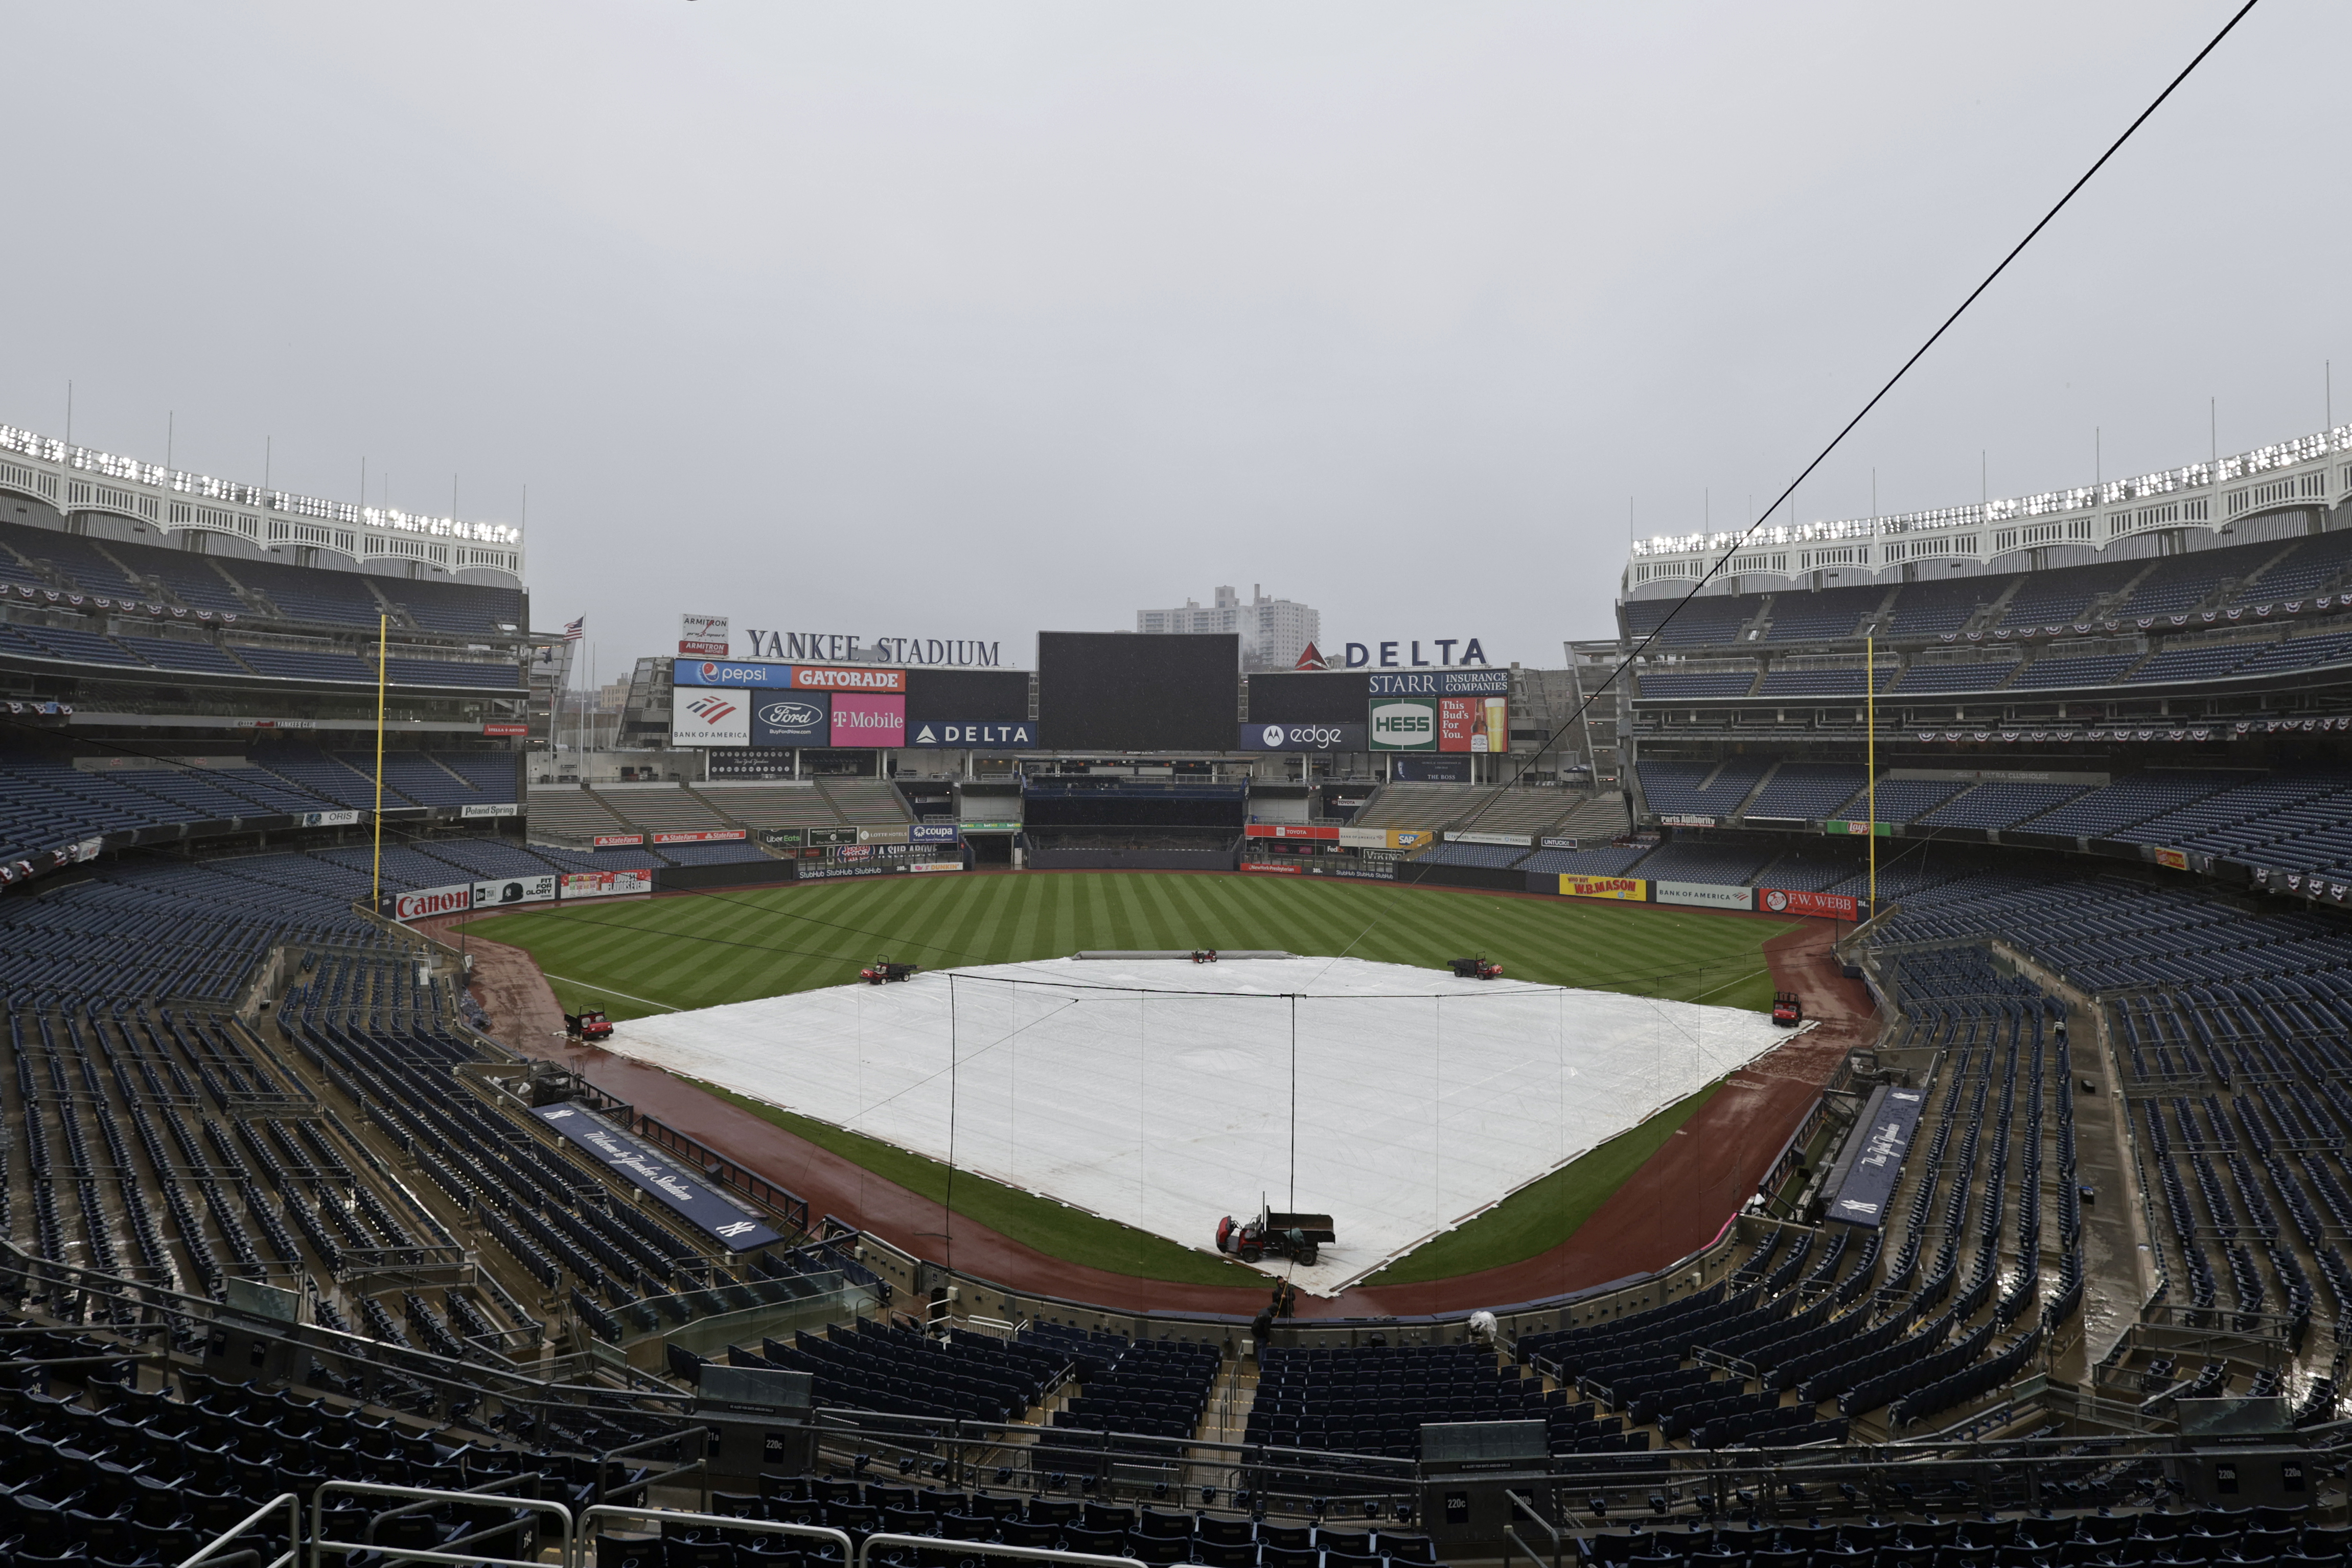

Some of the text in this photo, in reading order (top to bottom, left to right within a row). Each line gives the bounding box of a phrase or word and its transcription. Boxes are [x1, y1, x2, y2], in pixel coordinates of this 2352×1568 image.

[684, 618, 726, 627] ARMITRON
[745, 629, 1001, 666] YANKEE STADIUM
[1346, 638, 1489, 668] DELTA
[722, 667, 766, 683] pepsi
[798, 671, 898, 688] GATORADE
[1446, 673, 1508, 683] INSURANCE
[1369, 675, 1438, 693] STARR
[1445, 682, 1508, 692] COMPANIES
[1442, 701, 1464, 709] This
[770, 706, 812, 724] Ford
[1442, 710, 1469, 719] Bud's
[1376, 717, 1429, 732] HESS
[1442, 720, 1459, 729] For
[945, 726, 1029, 743] DELTA
[1290, 725, 1342, 749] edge
[1442, 730, 1463, 739] You.
[465, 805, 514, 816] Poland Spring
[329, 812, 352, 821] ORIS
[1681, 815, 1715, 824] Authority
[926, 826, 953, 837] coupa
[1849, 822, 1867, 834] Lay's
[1399, 835, 1415, 844] SAP
[879, 846, 885, 859] A
[614, 872, 638, 882] LOUDEST
[799, 870, 824, 879] StubHub
[397, 891, 468, 918] Canon
[1815, 895, 1852, 910] WEBB
[584, 1131, 621, 1154] Welcome
[609, 1154, 662, 1177] Yankee
[650, 1175, 693, 1201] Stadium
[766, 1439, 782, 1449] 220c
[2218, 1470, 2235, 1479] 220b
[1448, 1498, 1466, 1508] 220c
